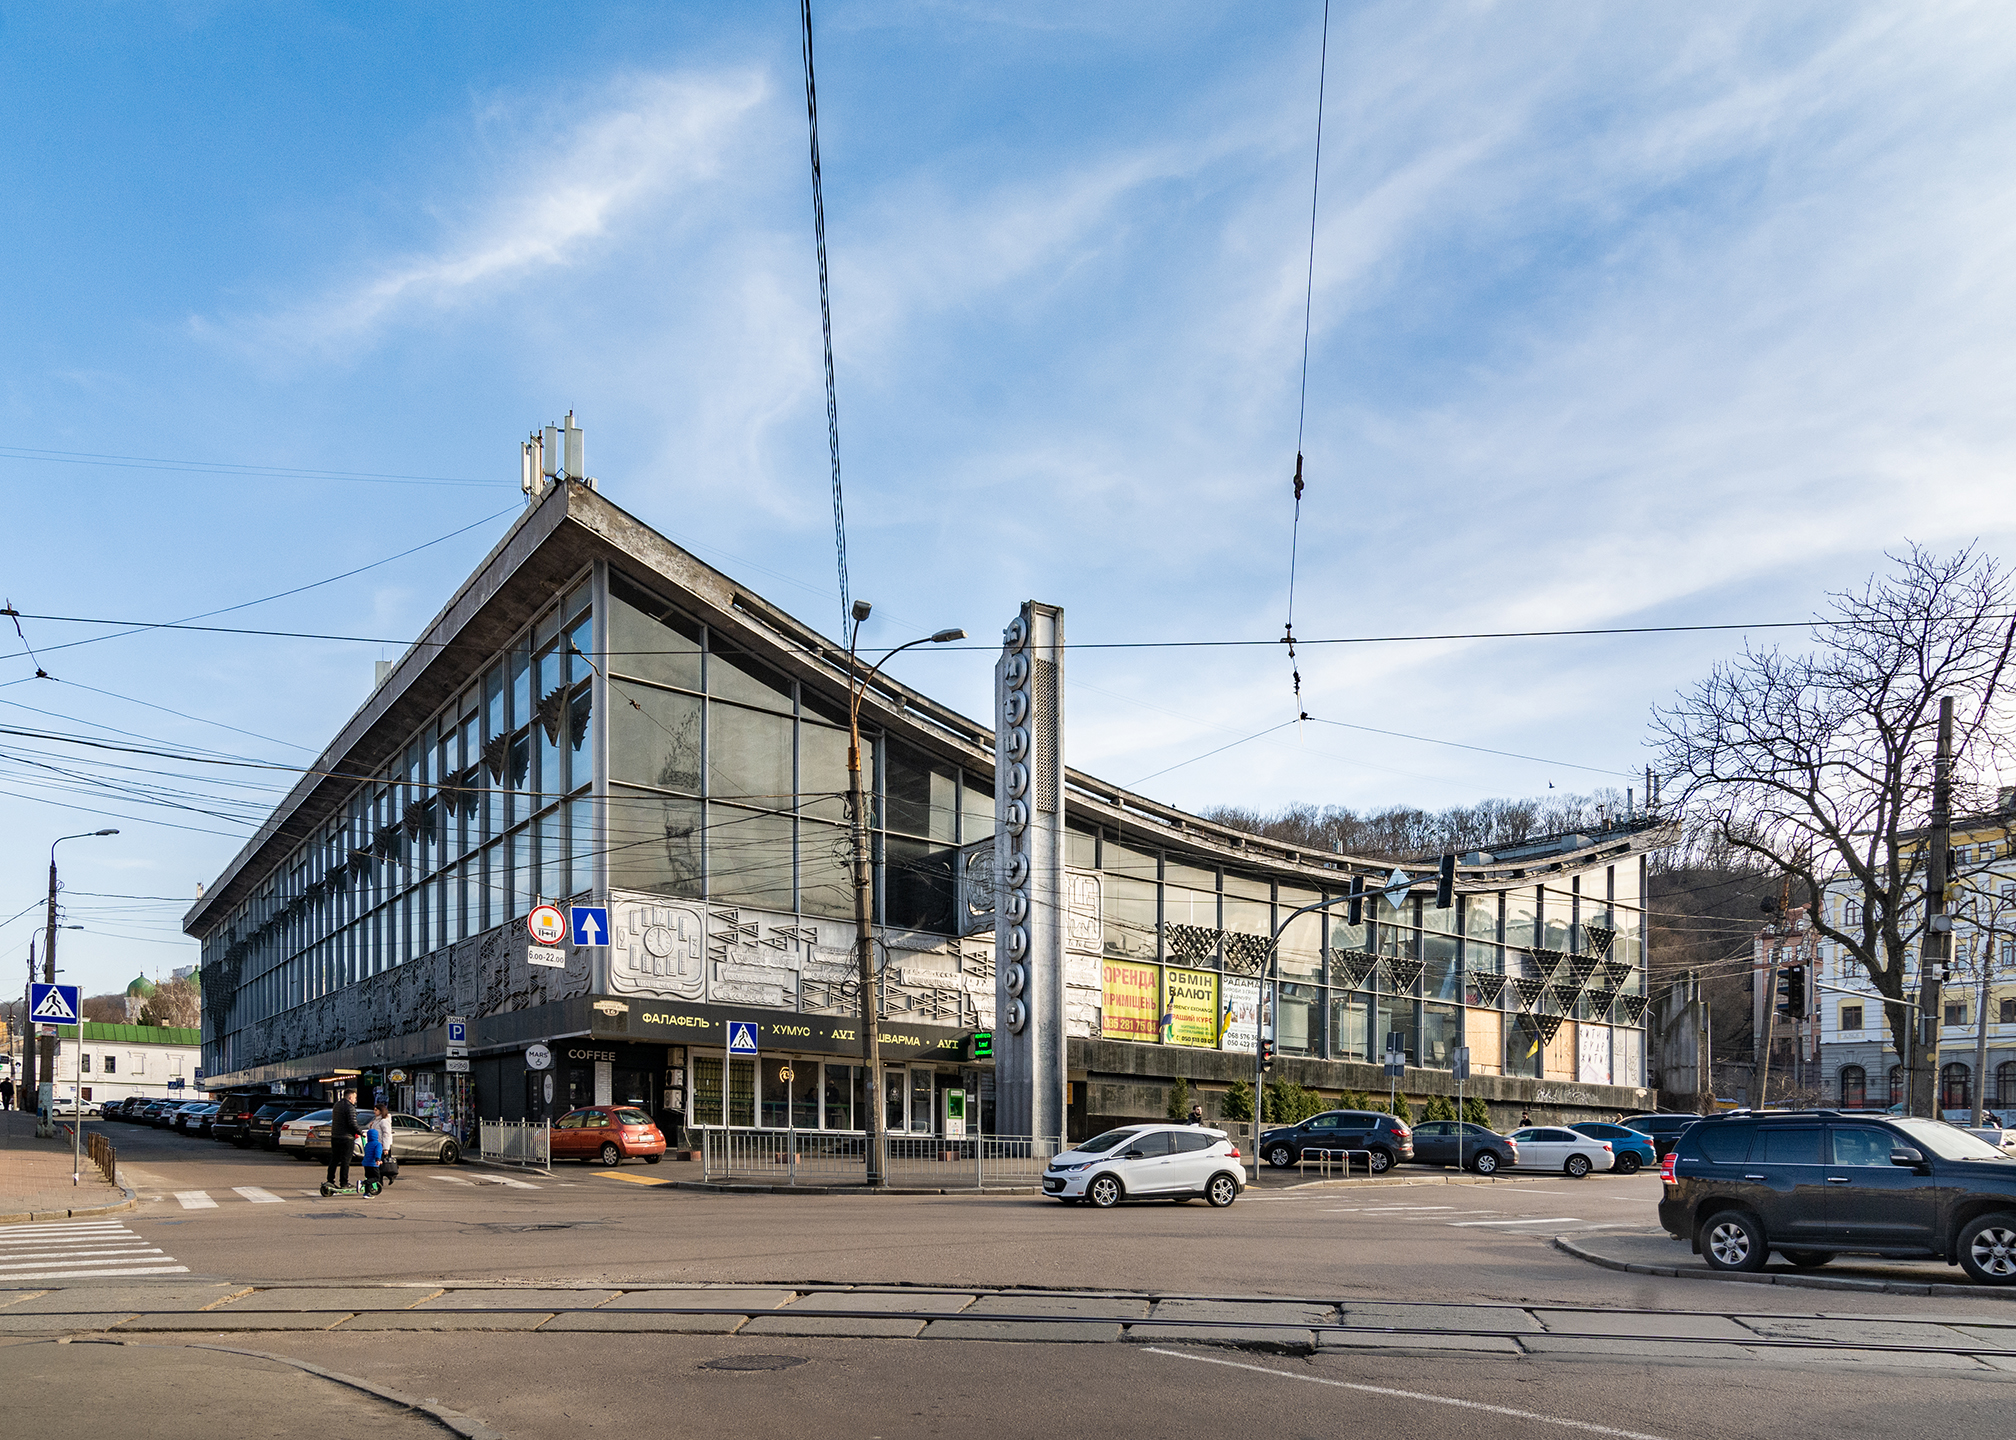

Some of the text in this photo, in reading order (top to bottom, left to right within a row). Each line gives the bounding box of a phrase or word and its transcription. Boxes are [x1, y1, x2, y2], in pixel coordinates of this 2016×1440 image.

[528, 950, 565, 964] 6.00-22.00
[1103, 966, 1156, 990] ОРЕНДА
[1168, 971, 1212, 987] ОБМІН
[1168, 986, 1212, 1000] ВАЛЮТ
[1103, 993, 1156, 1010] ПРИМІЩЕНЬ
[447, 1016, 466, 1024] ЗОНА
[1104, 1017, 1156, 1032] 095 281 75 04
[1196, 1016, 1213, 1024] КУРС
[642, 1012, 710, 1028] ФАЛАФЕЛЬ
[772, 1024, 811, 1038] ХУМУС
[878, 1033, 921, 1047] ШВАРМА
[568, 1049, 616, 1061] COFFEE
